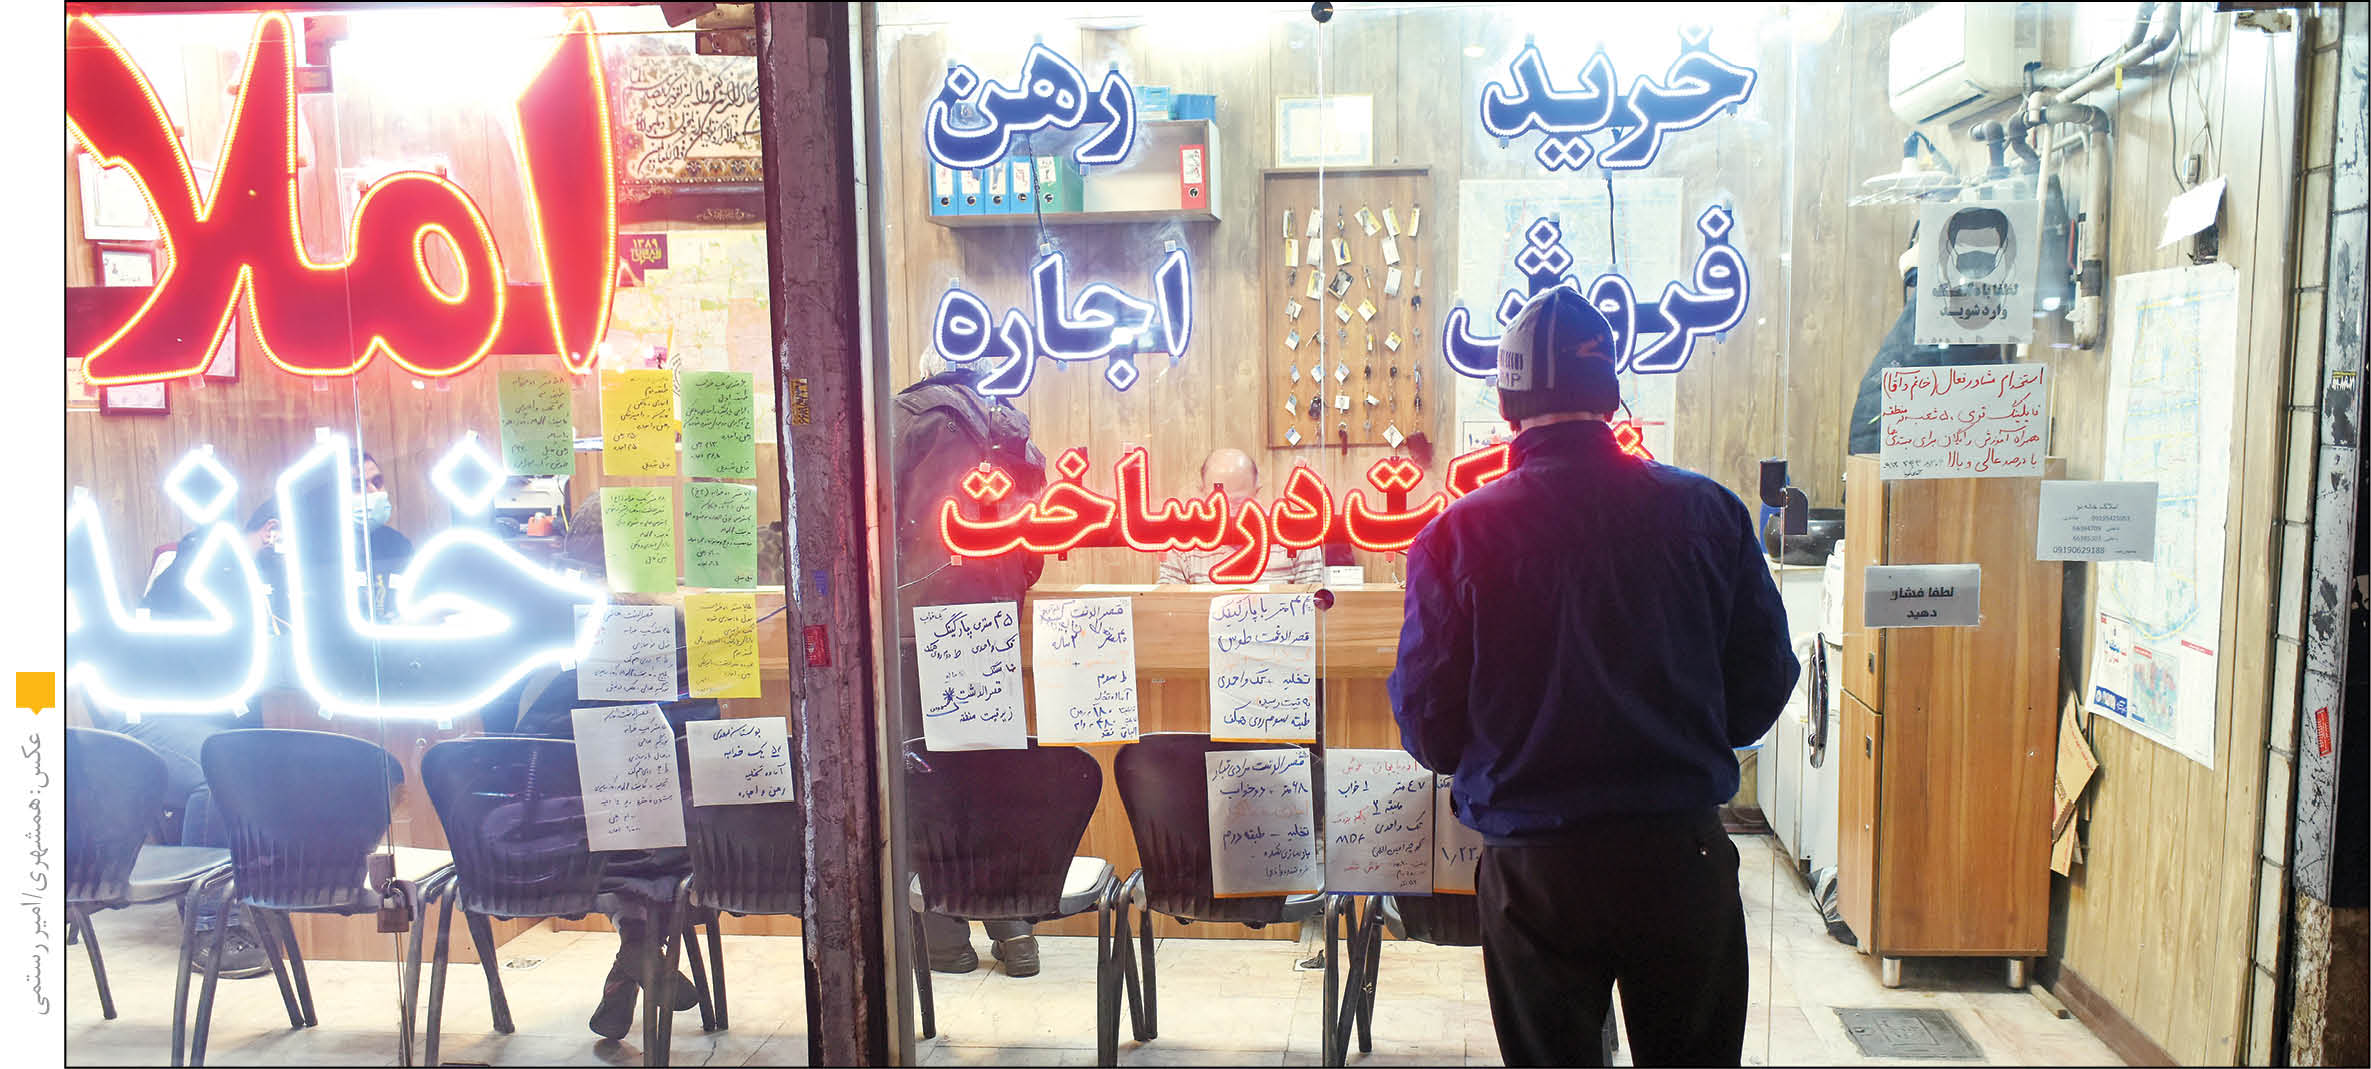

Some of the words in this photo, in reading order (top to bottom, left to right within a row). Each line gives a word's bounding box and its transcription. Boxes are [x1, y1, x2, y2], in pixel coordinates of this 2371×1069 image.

[1480, 24, 1757, 171] خرید
[926, 43, 1137, 171] رهن
[1982, 283, 1991, 299] با
[1993, 283, 2018, 295] لطفا
[1940, 304, 1980, 320] شوید
[1981, 304, 2008, 320] وارد
[933, 248, 1192, 396] اجاره
[1998, 367, 2044, 398] استخدام
[1958, 406, 1986, 423] قوی
[1914, 432, 1936, 448] برای
[1948, 451, 1963, 470] بالا
[1975, 448, 2001, 472] عالی
[2004, 457, 2026, 468] درصد
[2031, 453, 2038, 468] با
[940, 444, 1227, 559] ساخت
[1208, 462, 1333, 585] در
[1889, 587, 1924, 601] فشار
[1928, 586, 1954, 598] لطفا
[1260, 597, 1267, 618] با
[1906, 609, 1937, 619] دهید
[934, 611, 972, 639] پارکینگ
[972, 639, 995, 654] واحدی
[1218, 671, 1249, 689] واحدی
[1283, 673, 1310, 690] تخلیه
[1265, 714, 1289, 733] سوم
[738, 785, 758, 798] اجاره
[769, 786, 785, 797] رهن
[1338, 781, 1359, 797] خواب
[1245, 826, 1265, 844] طبقه
[1288, 824, 1309, 841] تخلیه
[1375, 820, 1402, 834] واحدی
